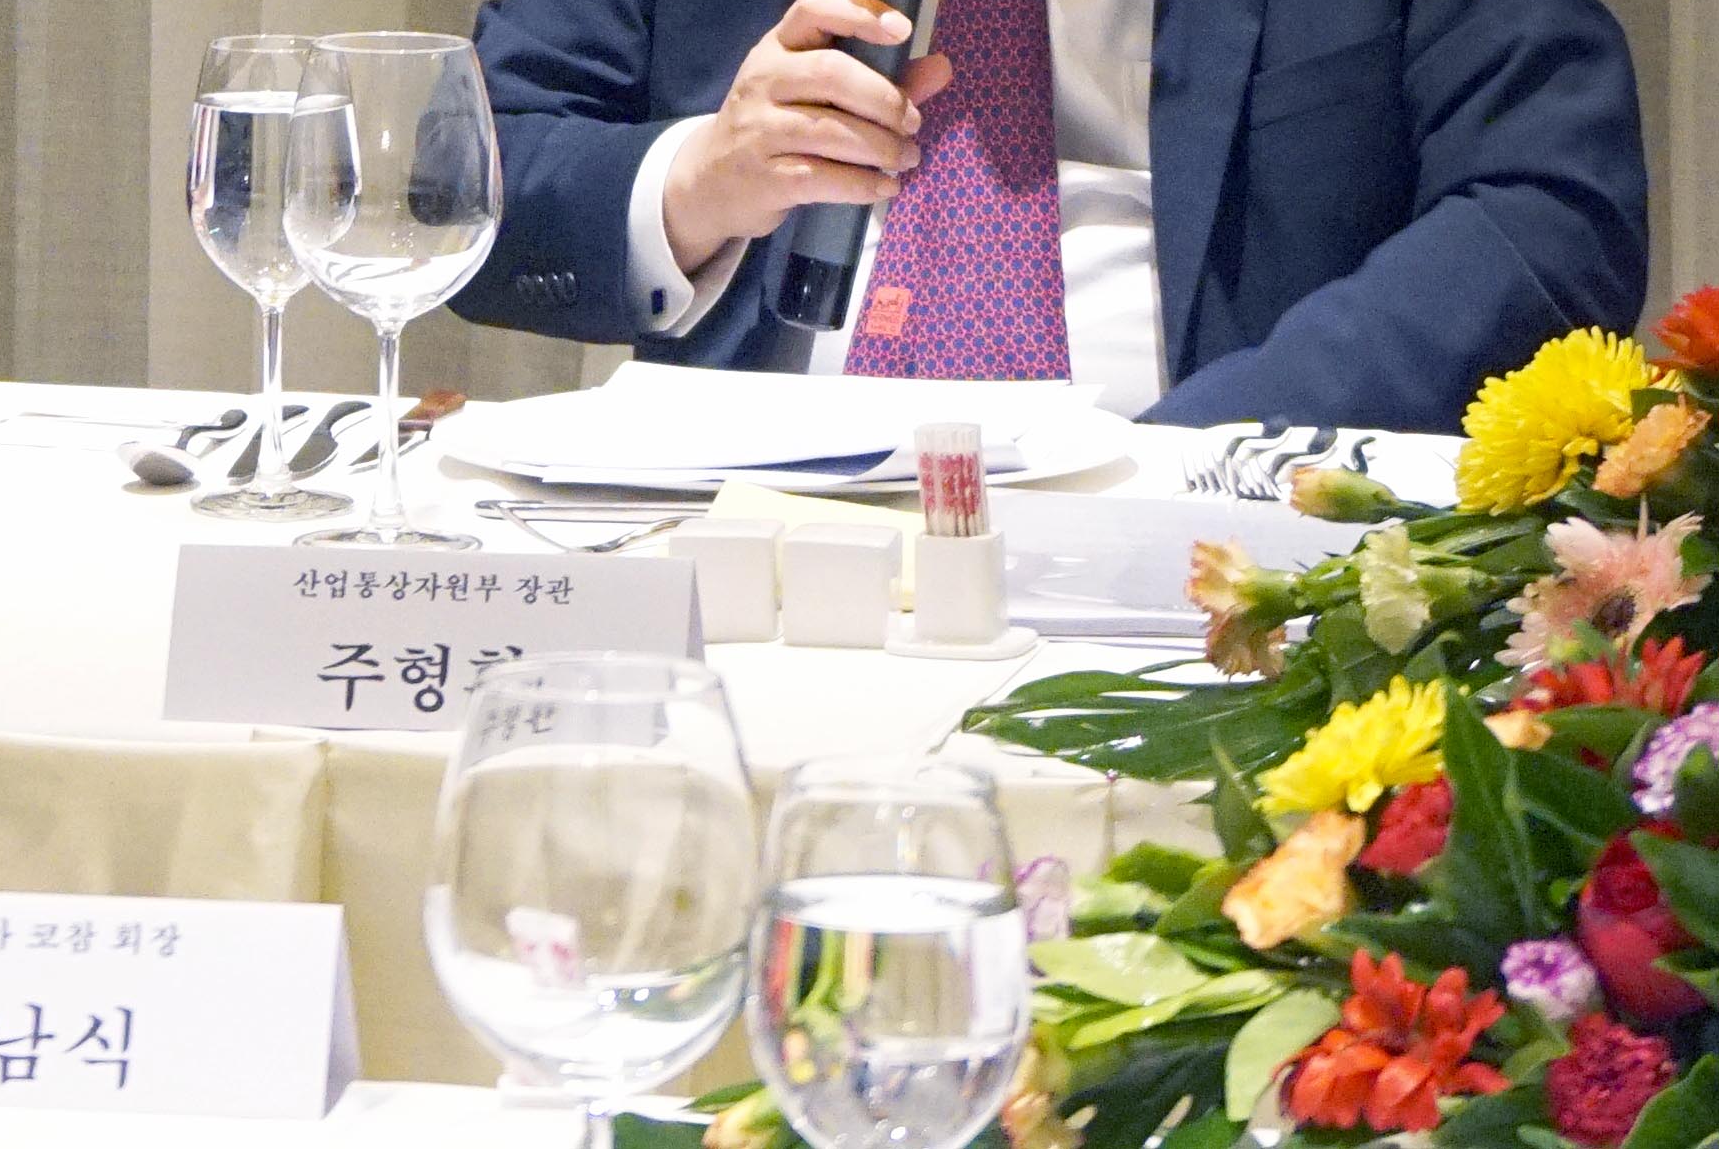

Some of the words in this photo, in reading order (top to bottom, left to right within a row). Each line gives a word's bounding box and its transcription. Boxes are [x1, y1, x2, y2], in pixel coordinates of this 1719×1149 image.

[293, 568, 502, 603] 산업통상자원부
[512, 576, 575, 605] 장관
[113, 922, 182, 958] 회장
